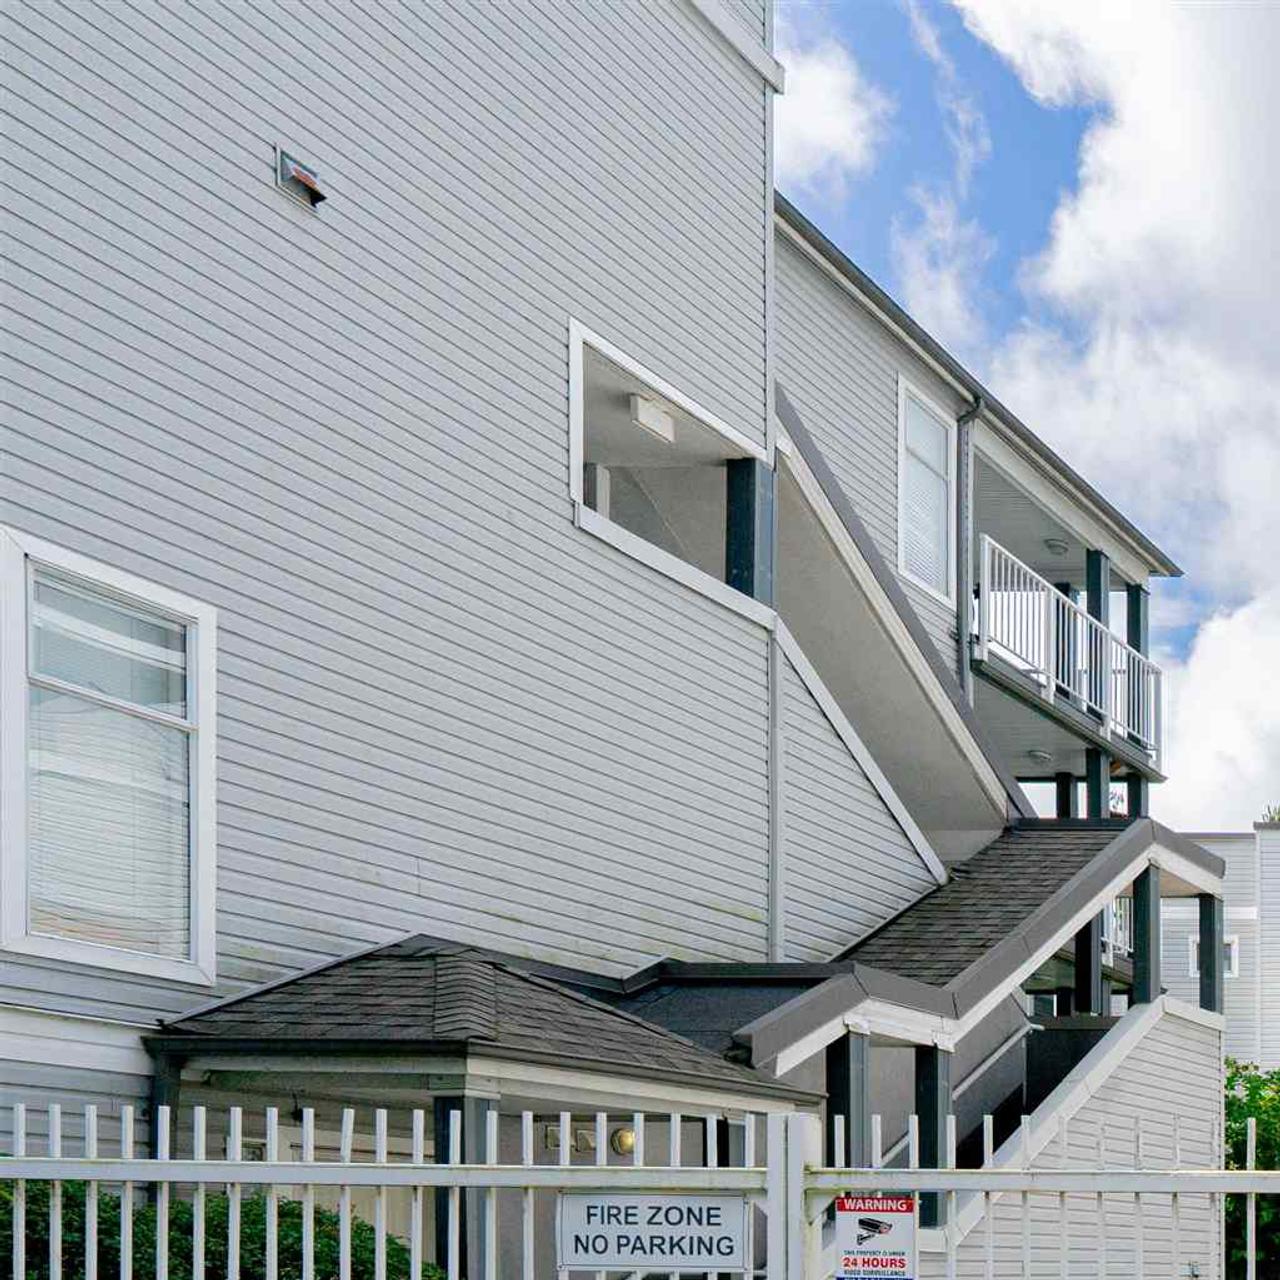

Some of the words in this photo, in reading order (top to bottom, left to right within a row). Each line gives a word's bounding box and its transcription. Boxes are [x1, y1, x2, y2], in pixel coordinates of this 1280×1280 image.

[844, 1199, 907, 1211] WARNING
[586, 1205, 639, 1225] FIRE
[647, 1206, 722, 1226] ZONE
[574, 1234, 608, 1254] NO
[617, 1235, 734, 1256] PARKING
[843, 1257, 858, 1268] 24
[862, 1257, 907, 1268] HOURS
